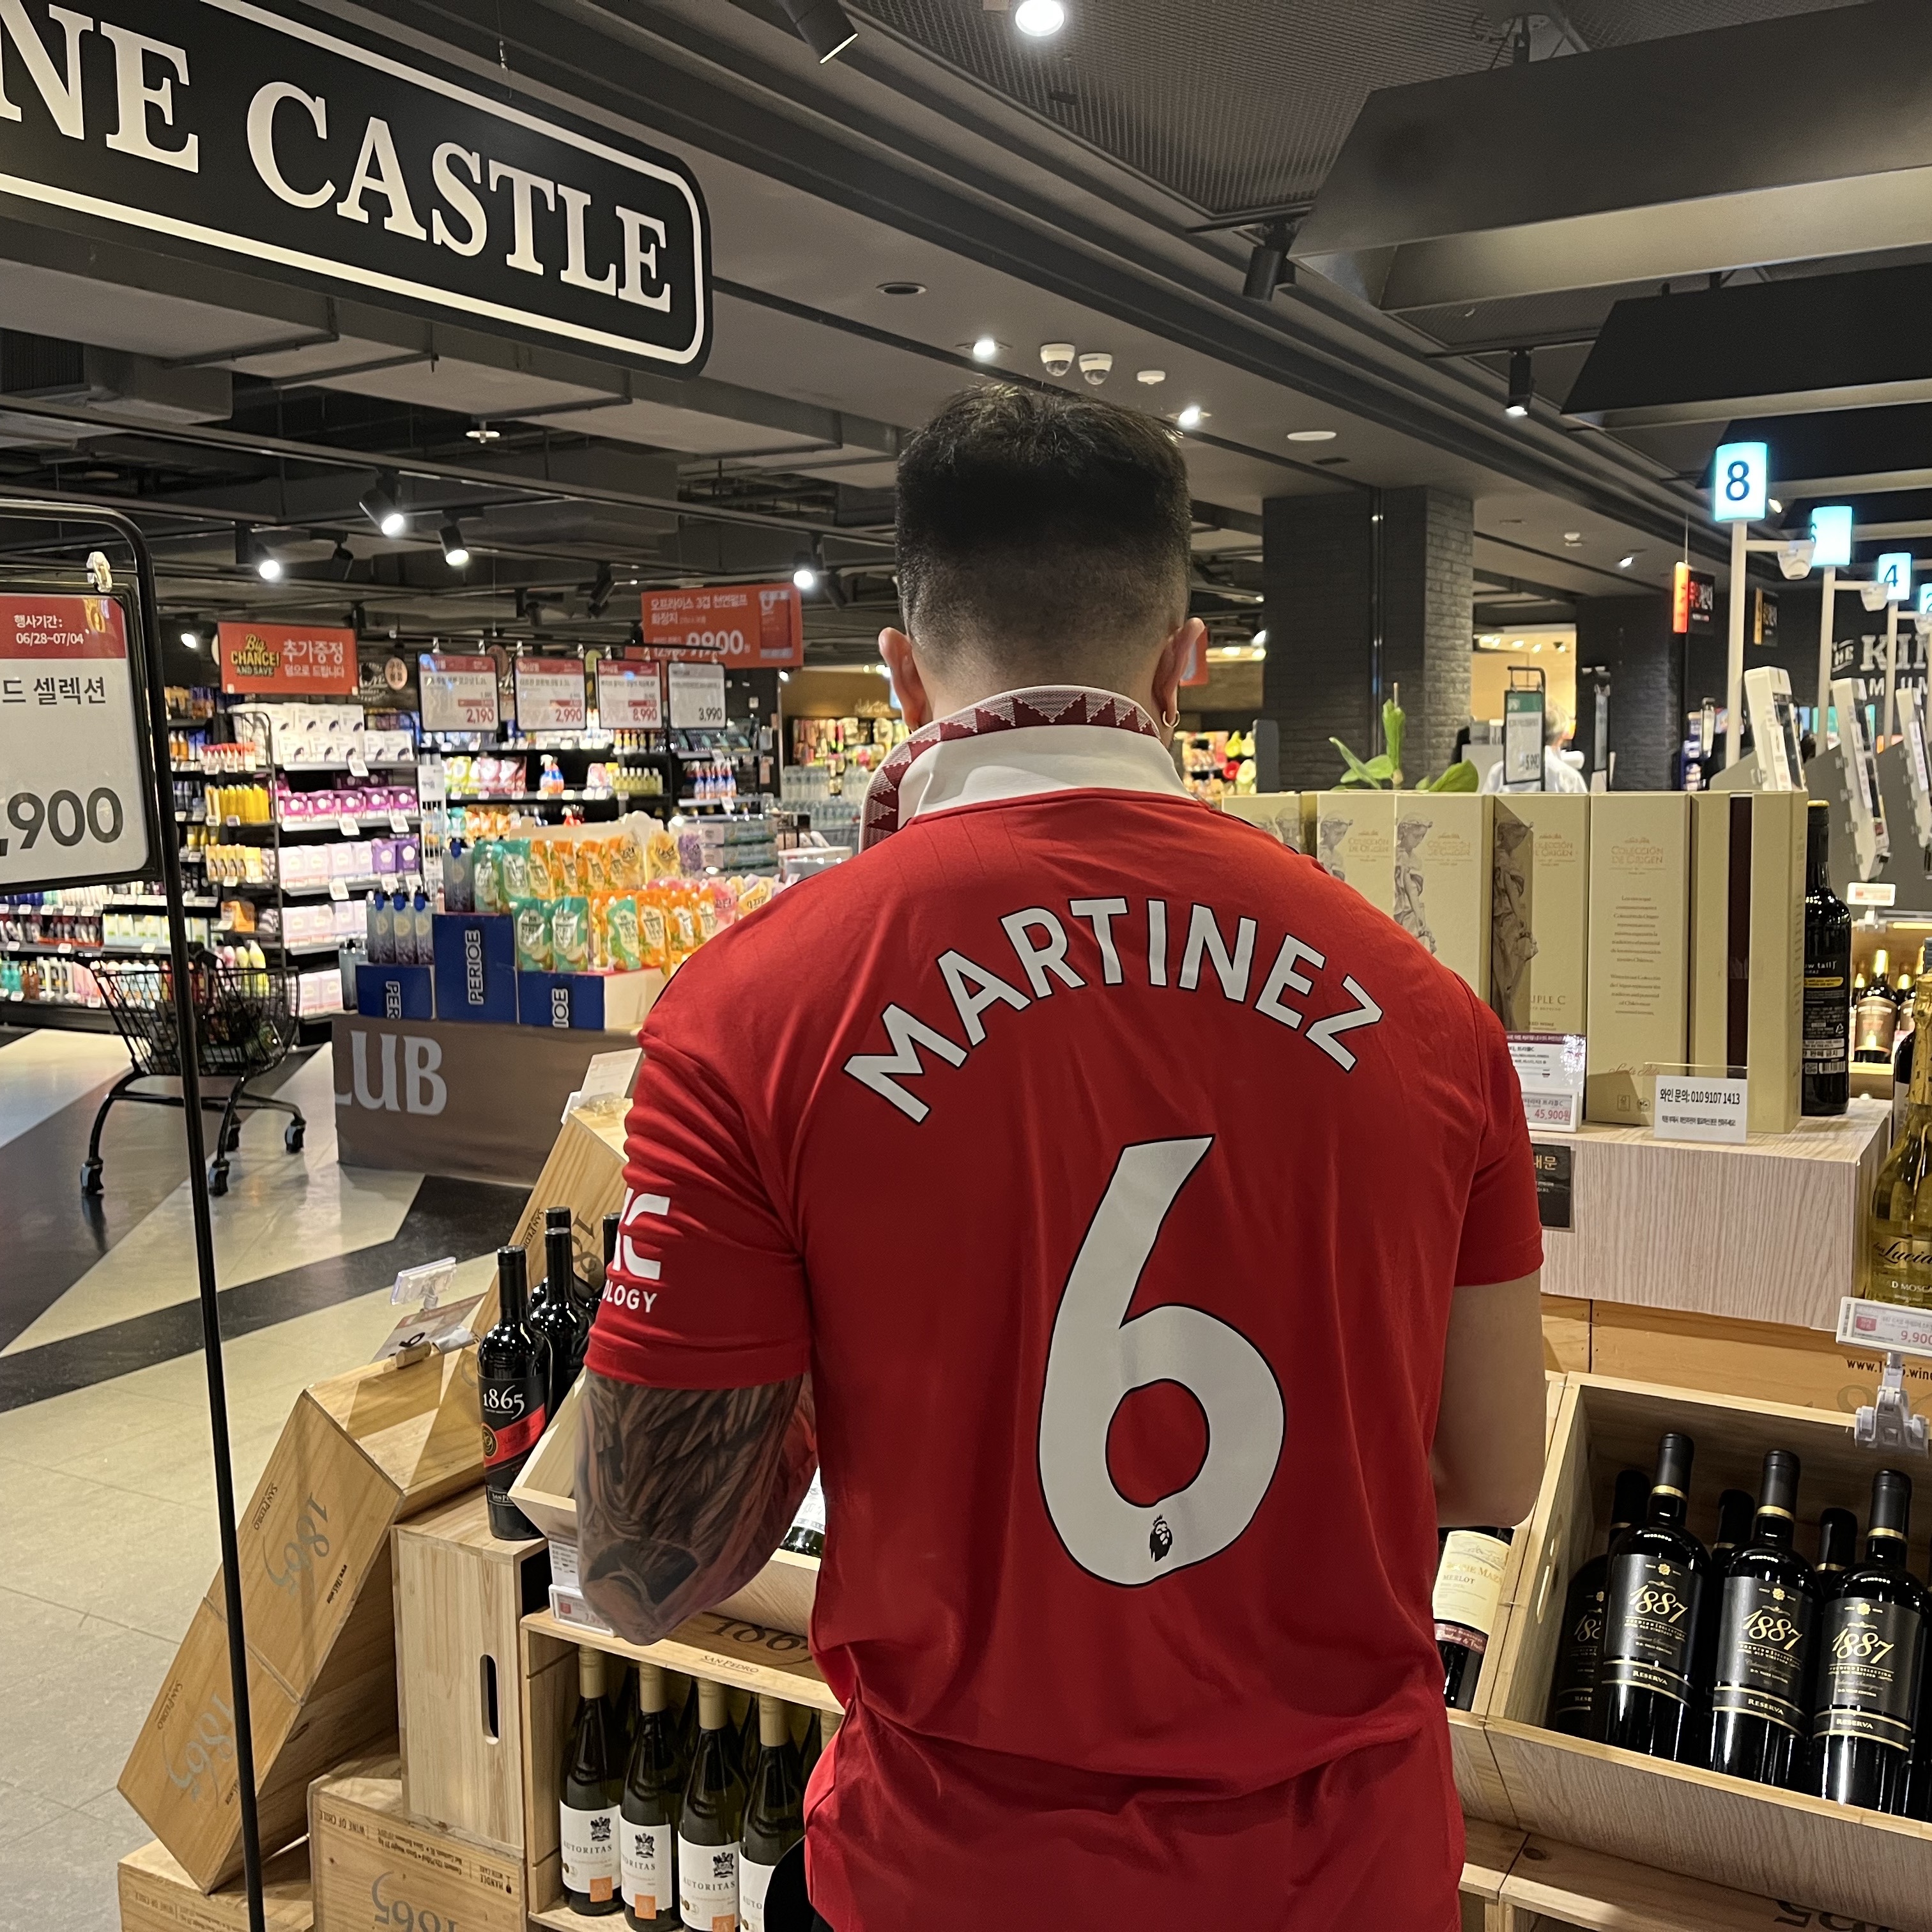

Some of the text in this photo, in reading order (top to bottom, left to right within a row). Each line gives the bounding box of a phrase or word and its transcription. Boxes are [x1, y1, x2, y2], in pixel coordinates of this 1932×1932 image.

[247, 81, 671, 313] CASTLE
[1726, 461, 1750, 501] 8
[1884, 564, 1899, 587] 4
[14, 615, 63, 629] 행사기간:
[245, 634, 266, 652] Big
[231, 650, 280, 666] CHANCE!
[33, 677, 106, 705] 셀렉션
[467, 709, 494, 724] 2,190
[556, 708, 582, 723] 2,990
[633, 708, 657, 721] 8,990
[698, 707, 723, 721] 3,990
[464, 929, 484, 1006] PERIOE
[1557, 995, 1566, 1005] C
[842, 896, 1384, 1124] MARTINEZ
[1660, 1088, 1740, 1105] 와인 문의: 010 9107 1413
[1035, 1133, 1287, 1588] 6
[483, 1384, 525, 1420] 1865
[254, 1483, 279, 1531] SAN PEDRO
[263, 1492, 330, 1595] 1865
[1443, 1574, 1475, 1584] MERLOT
[1629, 1584, 1688, 1623] 1887
[1742, 1609, 1803, 1651] 1887
[1832, 1628, 1894, 1664] 1887
[703, 1655, 759, 1673] SAN PEDRO
[1632, 1669, 1668, 1685] RESERVA
[1747, 1698, 1784, 1716] RESERVA
[1836, 1718, 1874, 1729] RESERVA
[162, 1693, 235, 1808] 1865
[339, 1817, 347, 1829] OF
[349, 1820, 365, 1836] WINE
[564, 1840, 612, 1854] AUTORITAS
[479, 1873, 503, 1890] HANDLE
[684, 1876, 735, 1891] AUTORITAS
[743, 1895, 763, 1910] AUTO
